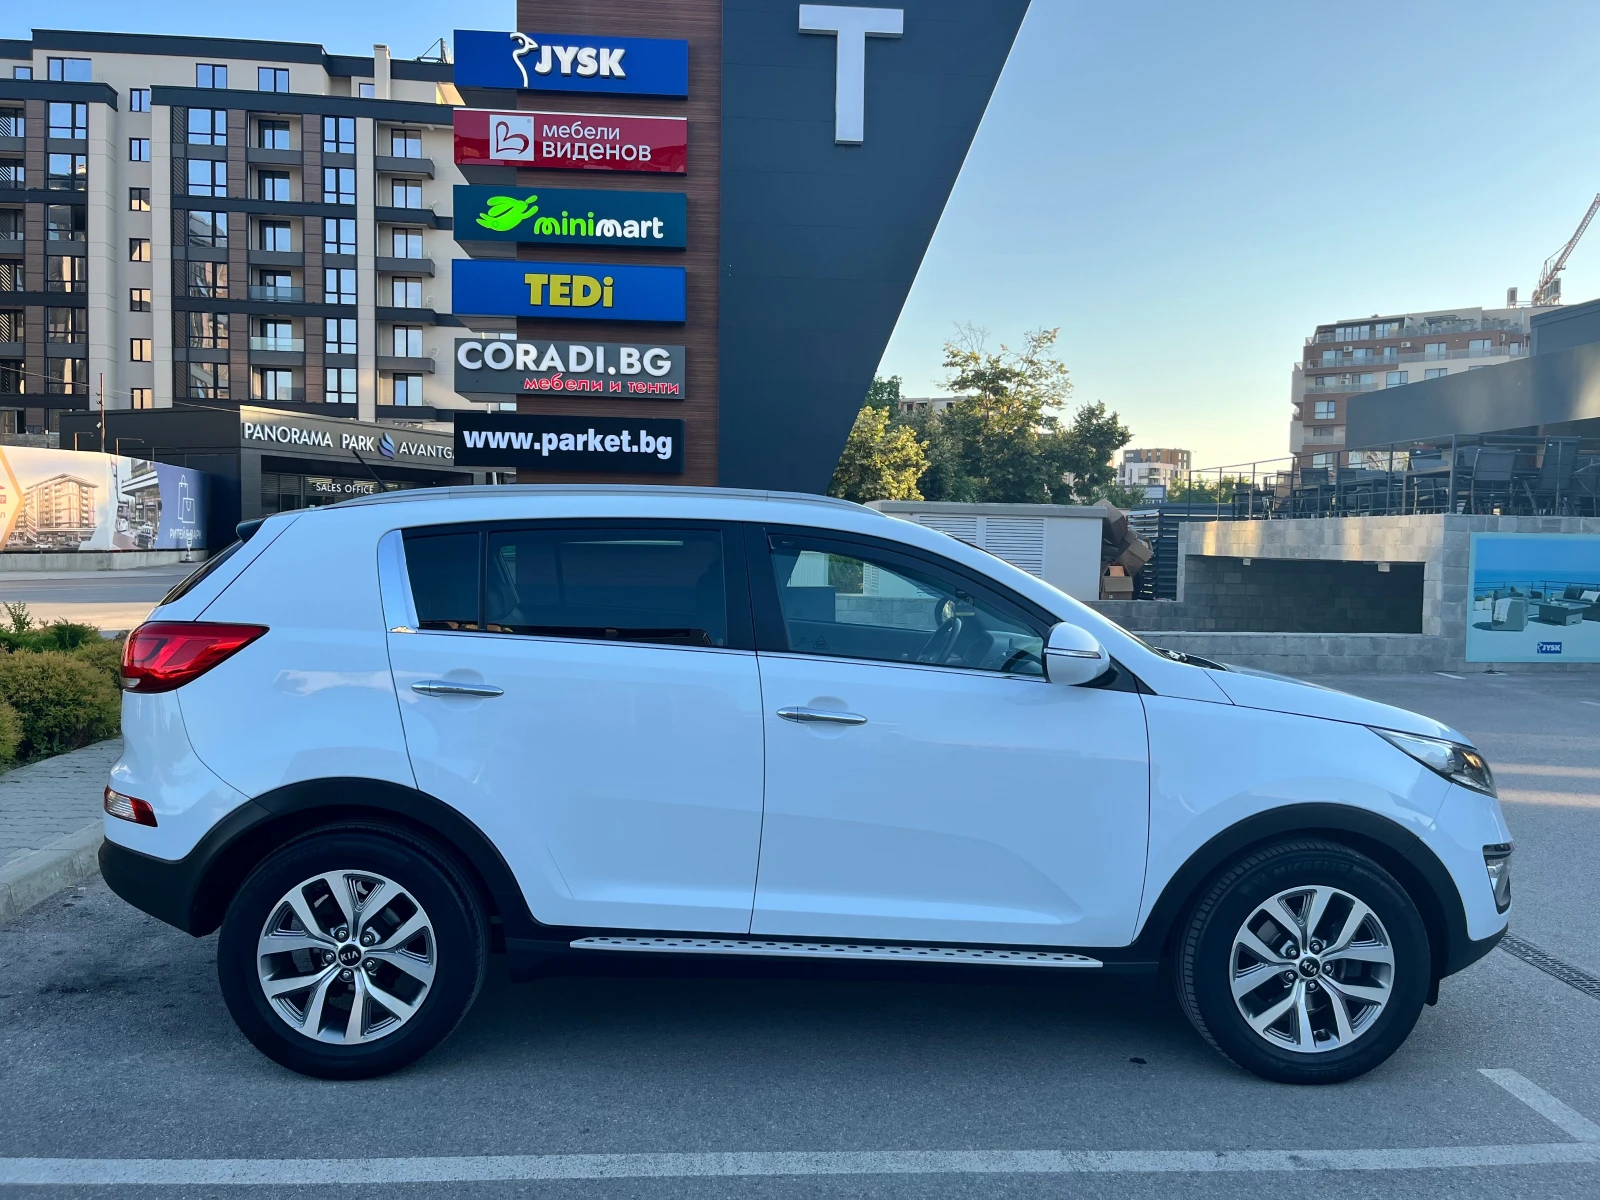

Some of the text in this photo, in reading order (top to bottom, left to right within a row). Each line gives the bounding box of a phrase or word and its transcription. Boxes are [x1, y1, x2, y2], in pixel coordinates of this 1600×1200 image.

[534, 45, 626, 79] JYSK
[799, 5, 904, 144] T
[542, 121, 620, 141] мебели
[534, 211, 664, 239] minimart
[524, 273, 614, 308] TEDi
[457, 341, 672, 377] CORADI.BG
[523, 372, 680, 395] мебели и тенти
[243, 422, 454, 459] PANORAMA PARK AVANTG
[463, 428, 673, 459] www.parket.bg
[316, 482, 374, 494] SALES OFFICE
[340, 951, 359, 961] KIA
[1302, 960, 1317, 975] KIA
